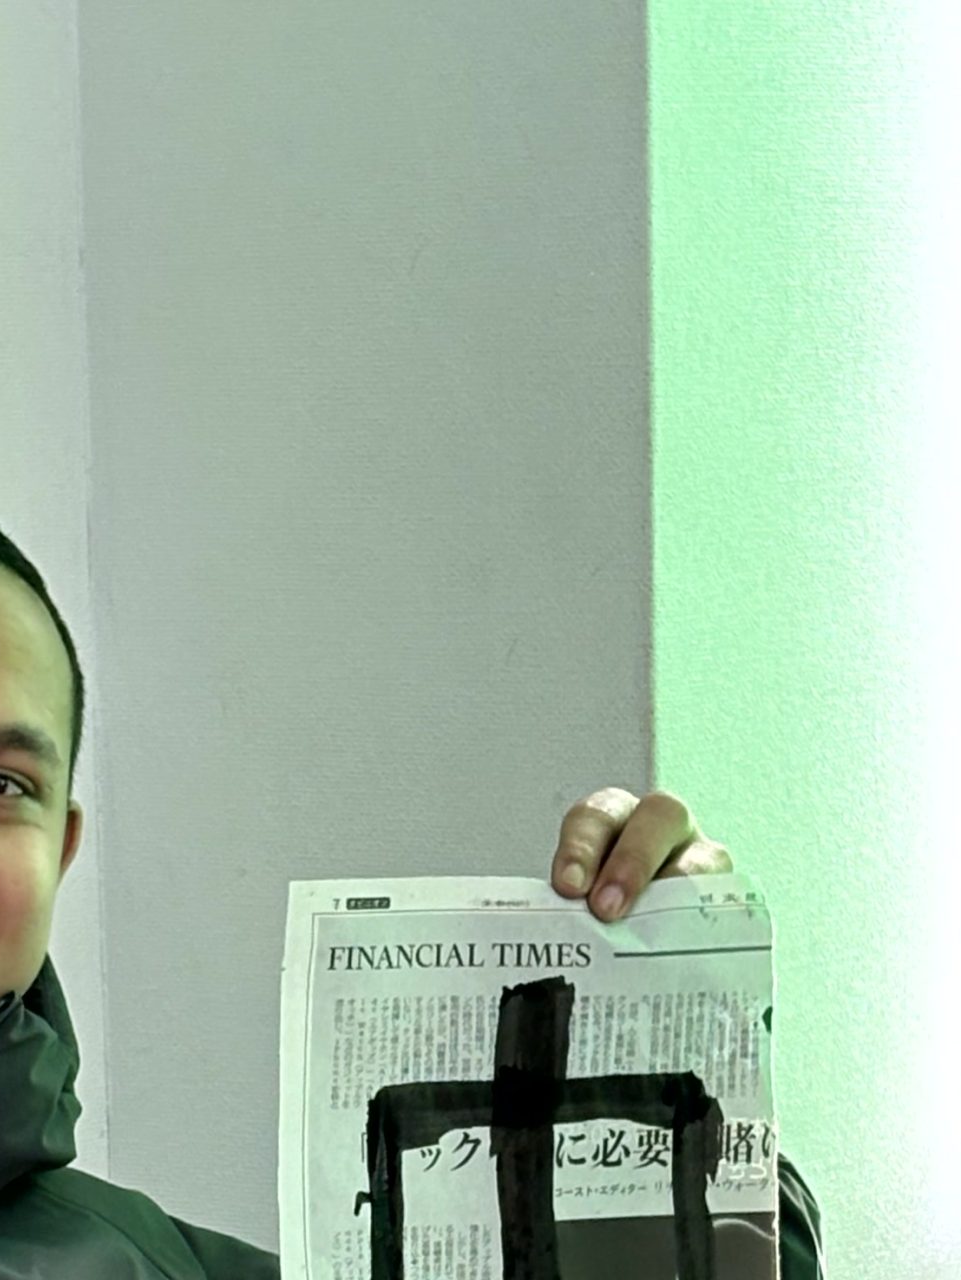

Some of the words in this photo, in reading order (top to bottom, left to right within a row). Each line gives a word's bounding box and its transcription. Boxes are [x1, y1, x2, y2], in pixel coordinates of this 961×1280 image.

[327, 943, 485, 971] FINANCIAL
[493, 942, 592, 968] TIMES
[555, 1128, 671, 1169] に必要
